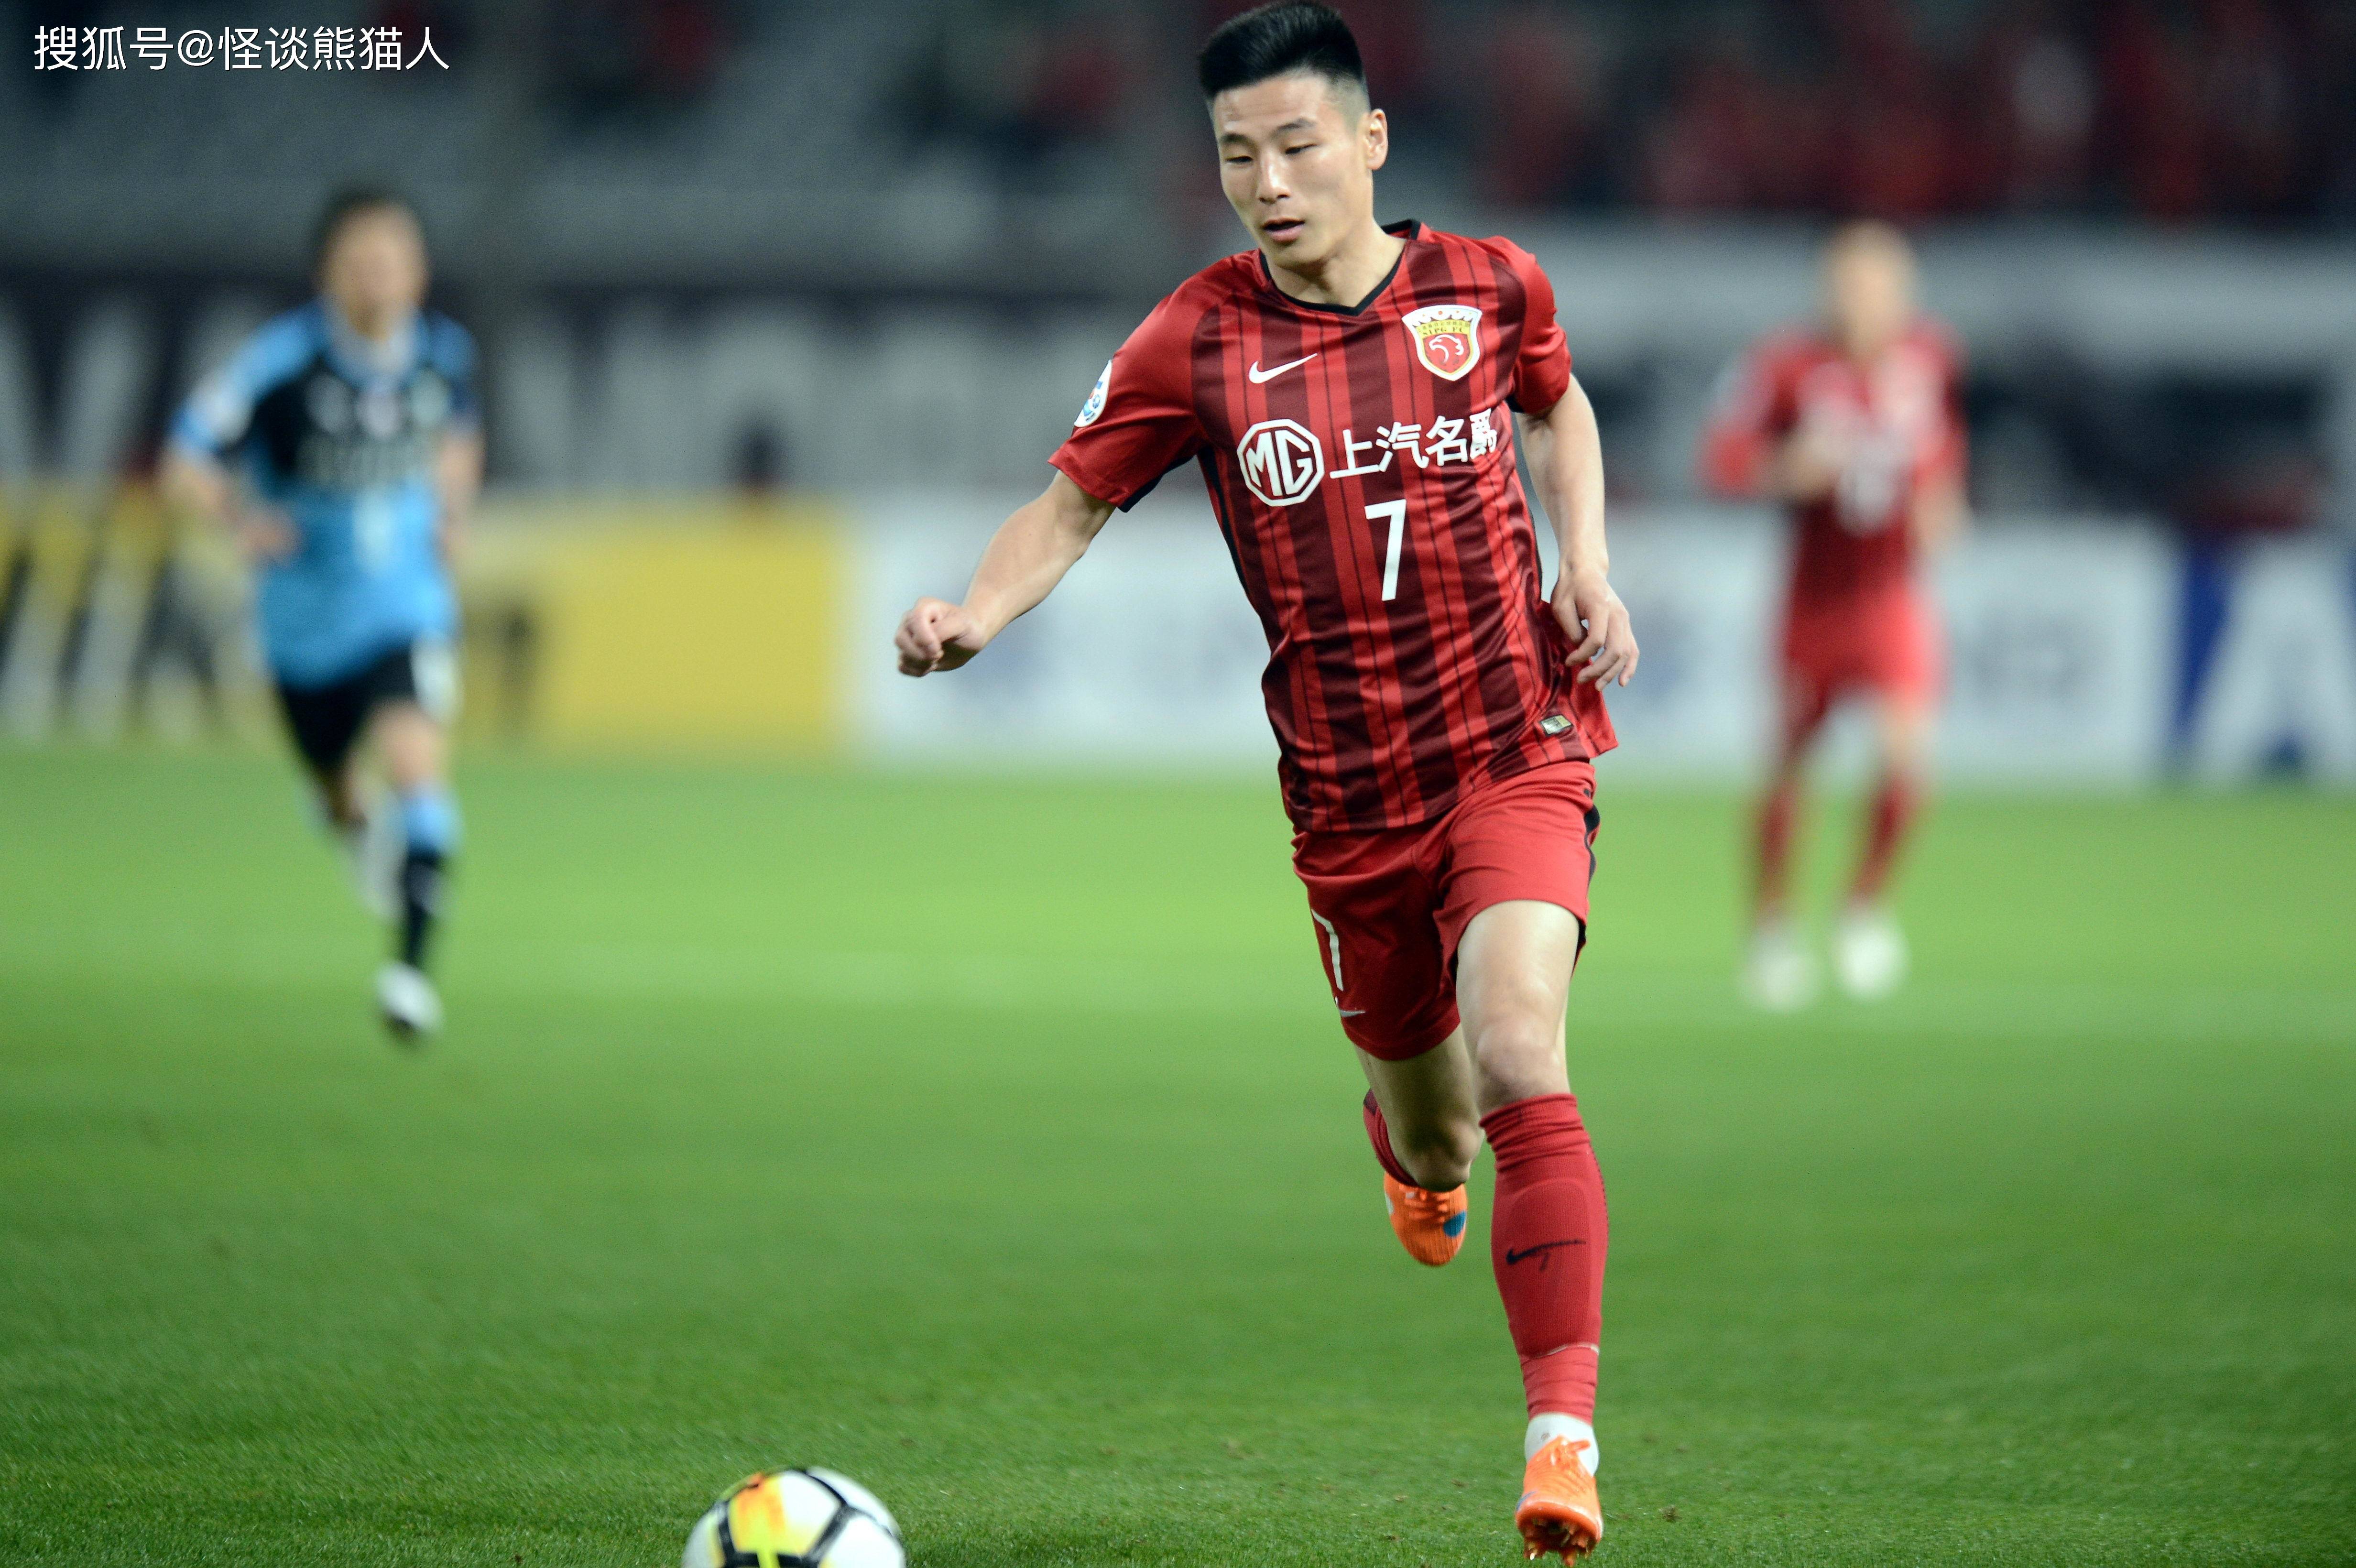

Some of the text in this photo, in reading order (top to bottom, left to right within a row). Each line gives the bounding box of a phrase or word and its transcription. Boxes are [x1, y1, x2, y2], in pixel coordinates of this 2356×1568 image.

[1244, 408, 1498, 498] MG 上汽名爵
[1364, 499, 1407, 601] 7
[1311, 908, 1344, 992] 7
